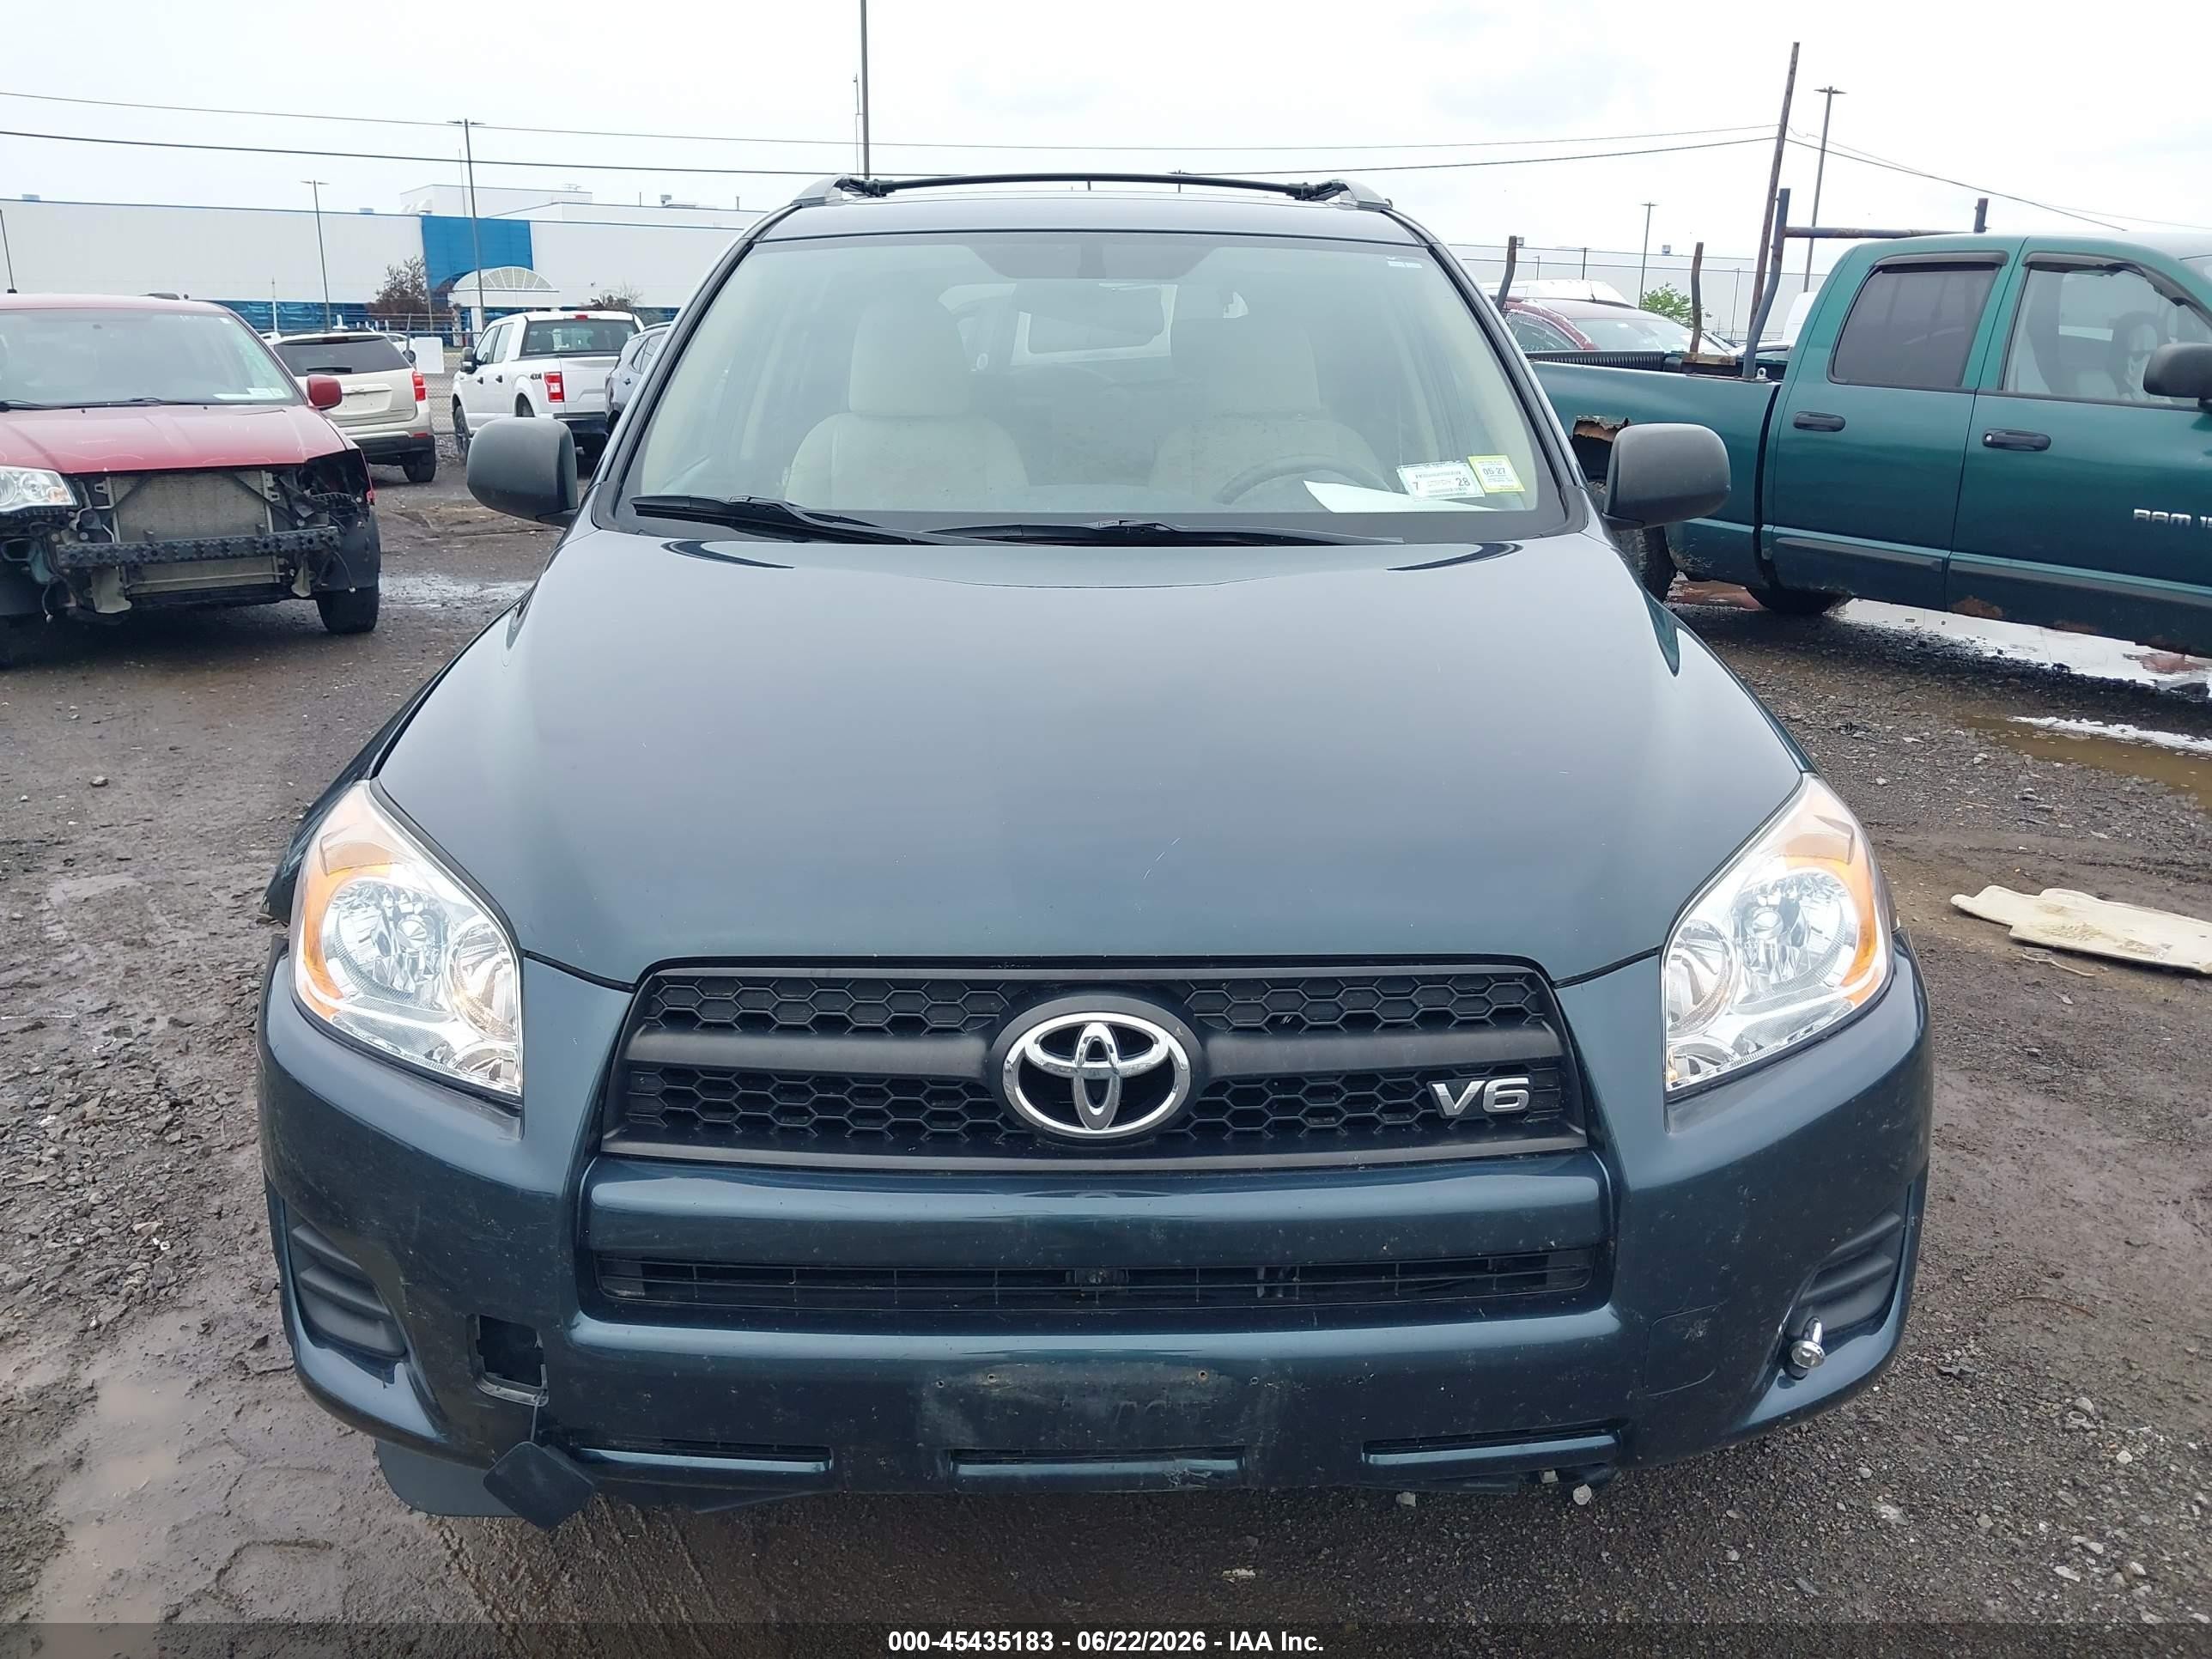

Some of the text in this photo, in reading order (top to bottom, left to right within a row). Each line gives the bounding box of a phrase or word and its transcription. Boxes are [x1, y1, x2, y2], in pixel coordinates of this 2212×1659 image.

[1455, 477, 1471, 487] 28
[2134, 508, 2191, 526] RAM
[1431, 1078, 1530, 1116] V6
